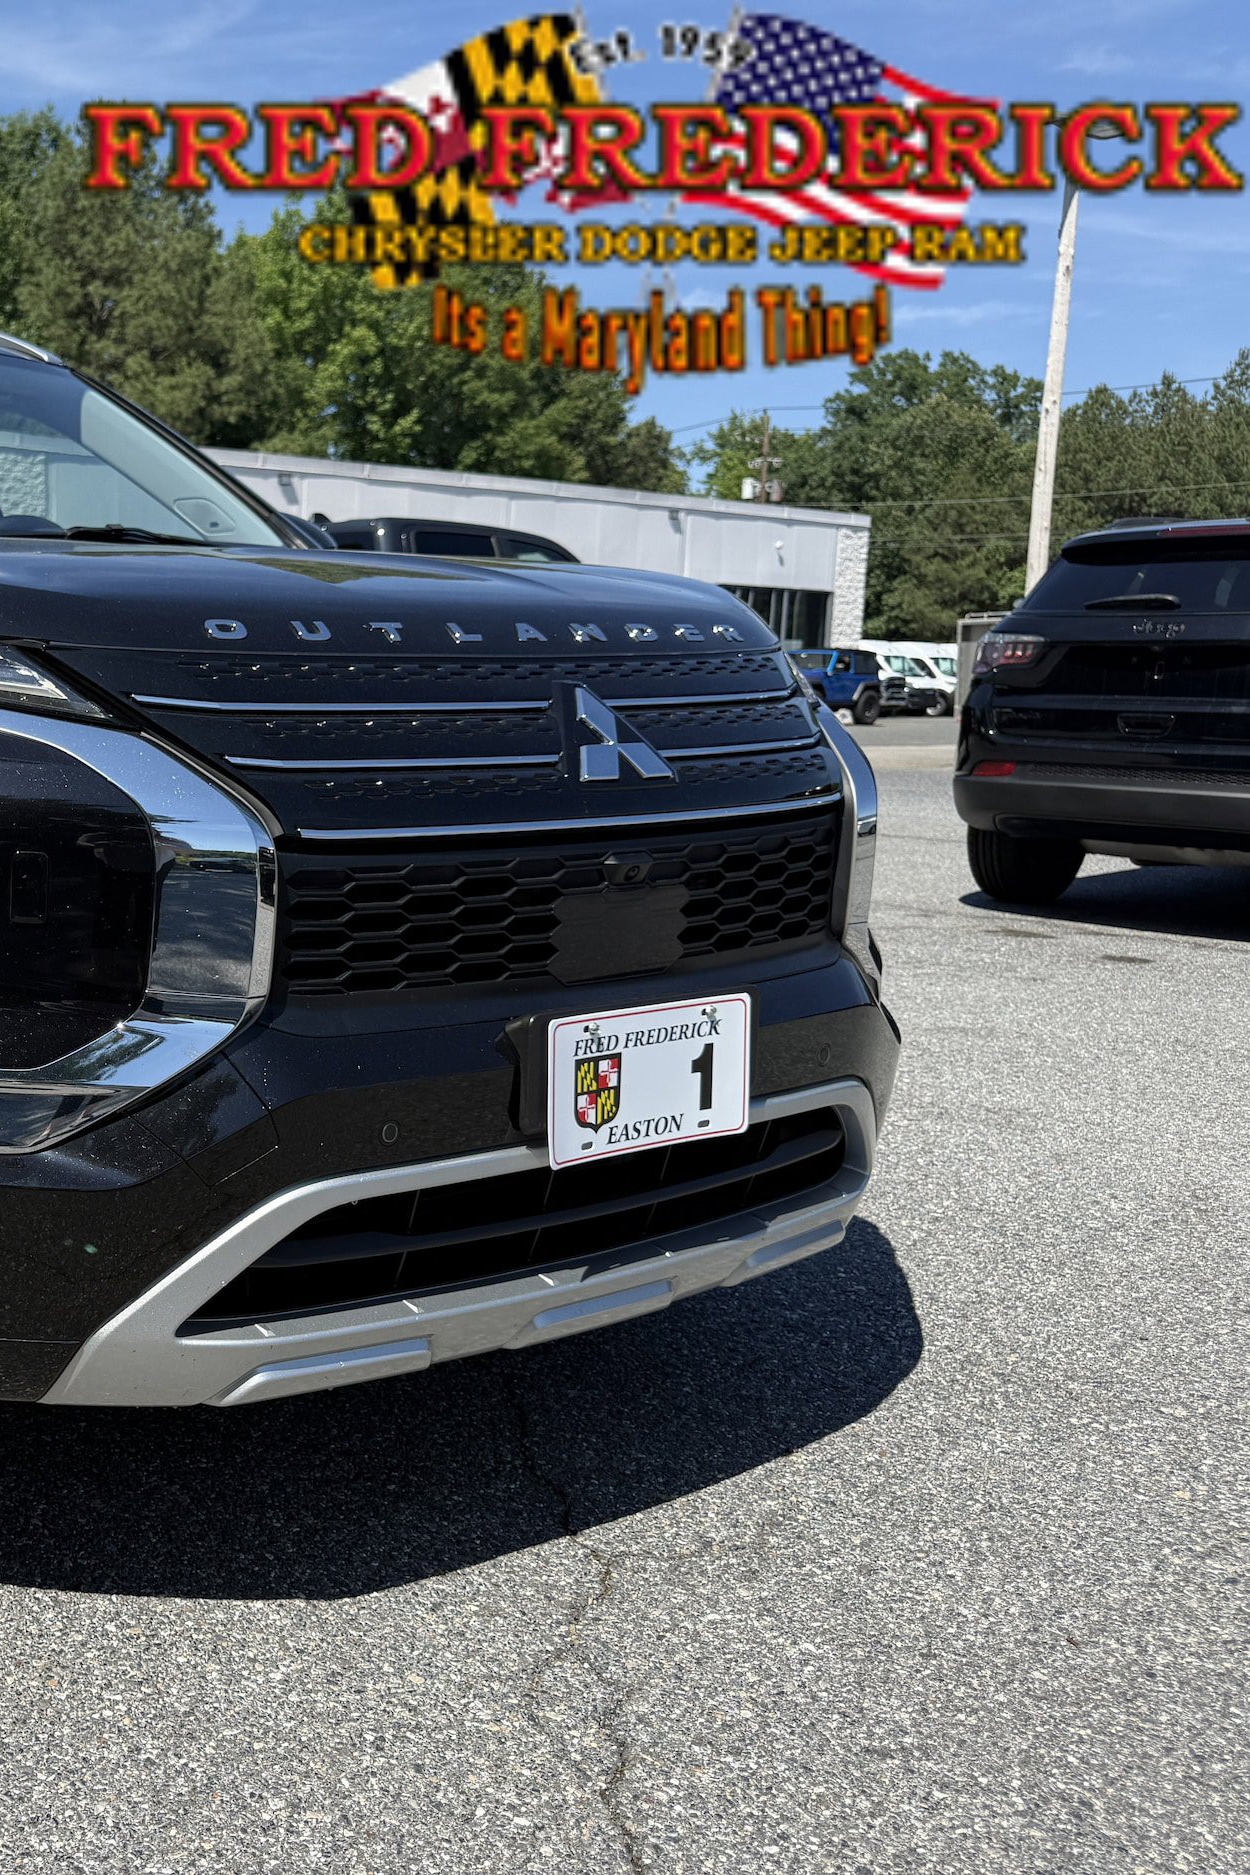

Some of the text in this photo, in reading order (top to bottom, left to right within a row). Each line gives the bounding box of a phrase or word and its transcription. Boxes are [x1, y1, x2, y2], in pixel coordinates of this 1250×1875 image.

[203, 617, 746, 645] OUTLANDER
[573, 1018, 723, 1057] FRED FREDERICK
[690, 1041, 715, 1111] 1
[606, 1112, 685, 1146] EASTON
